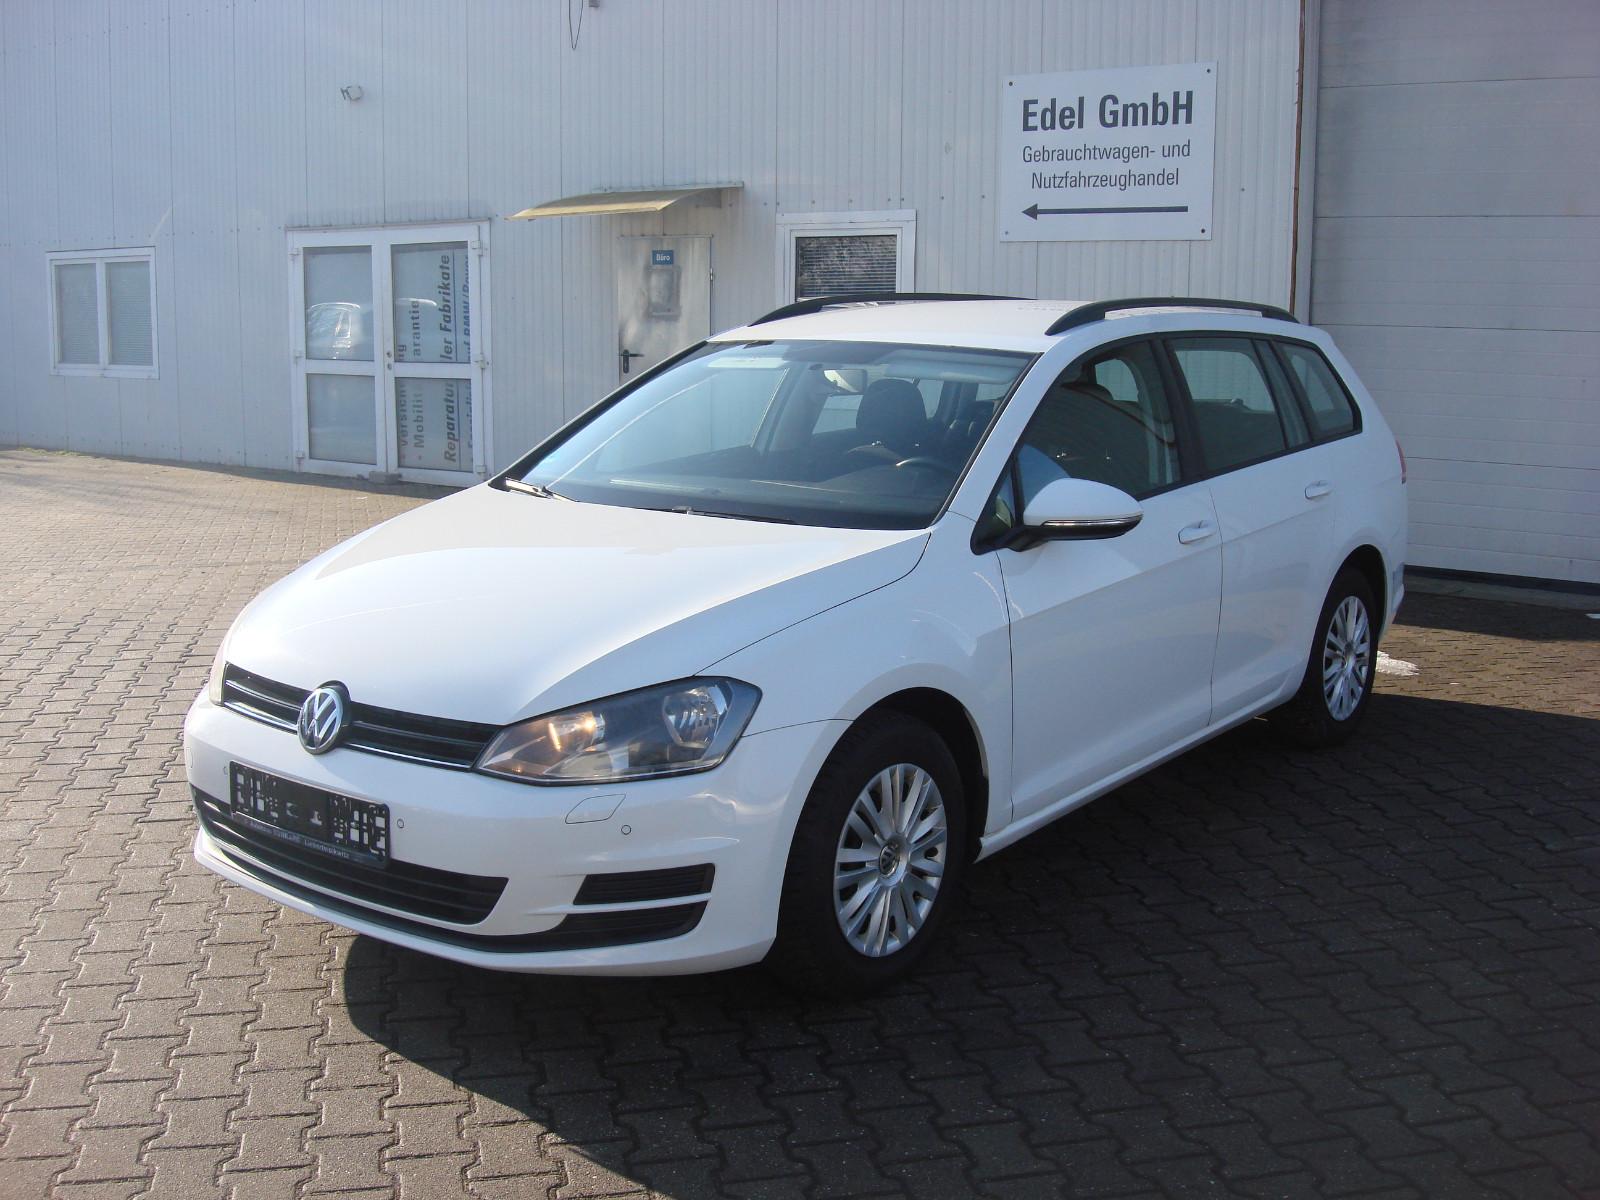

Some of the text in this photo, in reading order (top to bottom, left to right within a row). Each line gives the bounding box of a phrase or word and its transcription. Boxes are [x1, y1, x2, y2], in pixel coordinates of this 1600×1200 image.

[1022, 90, 1194, 132] Edel GmbH
[1022, 139, 1191, 164] Gebrauchtwagen- und
[1031, 168, 1180, 191] Nutzfahrzeughandel
[438, 254, 452, 333] Fabrikate
